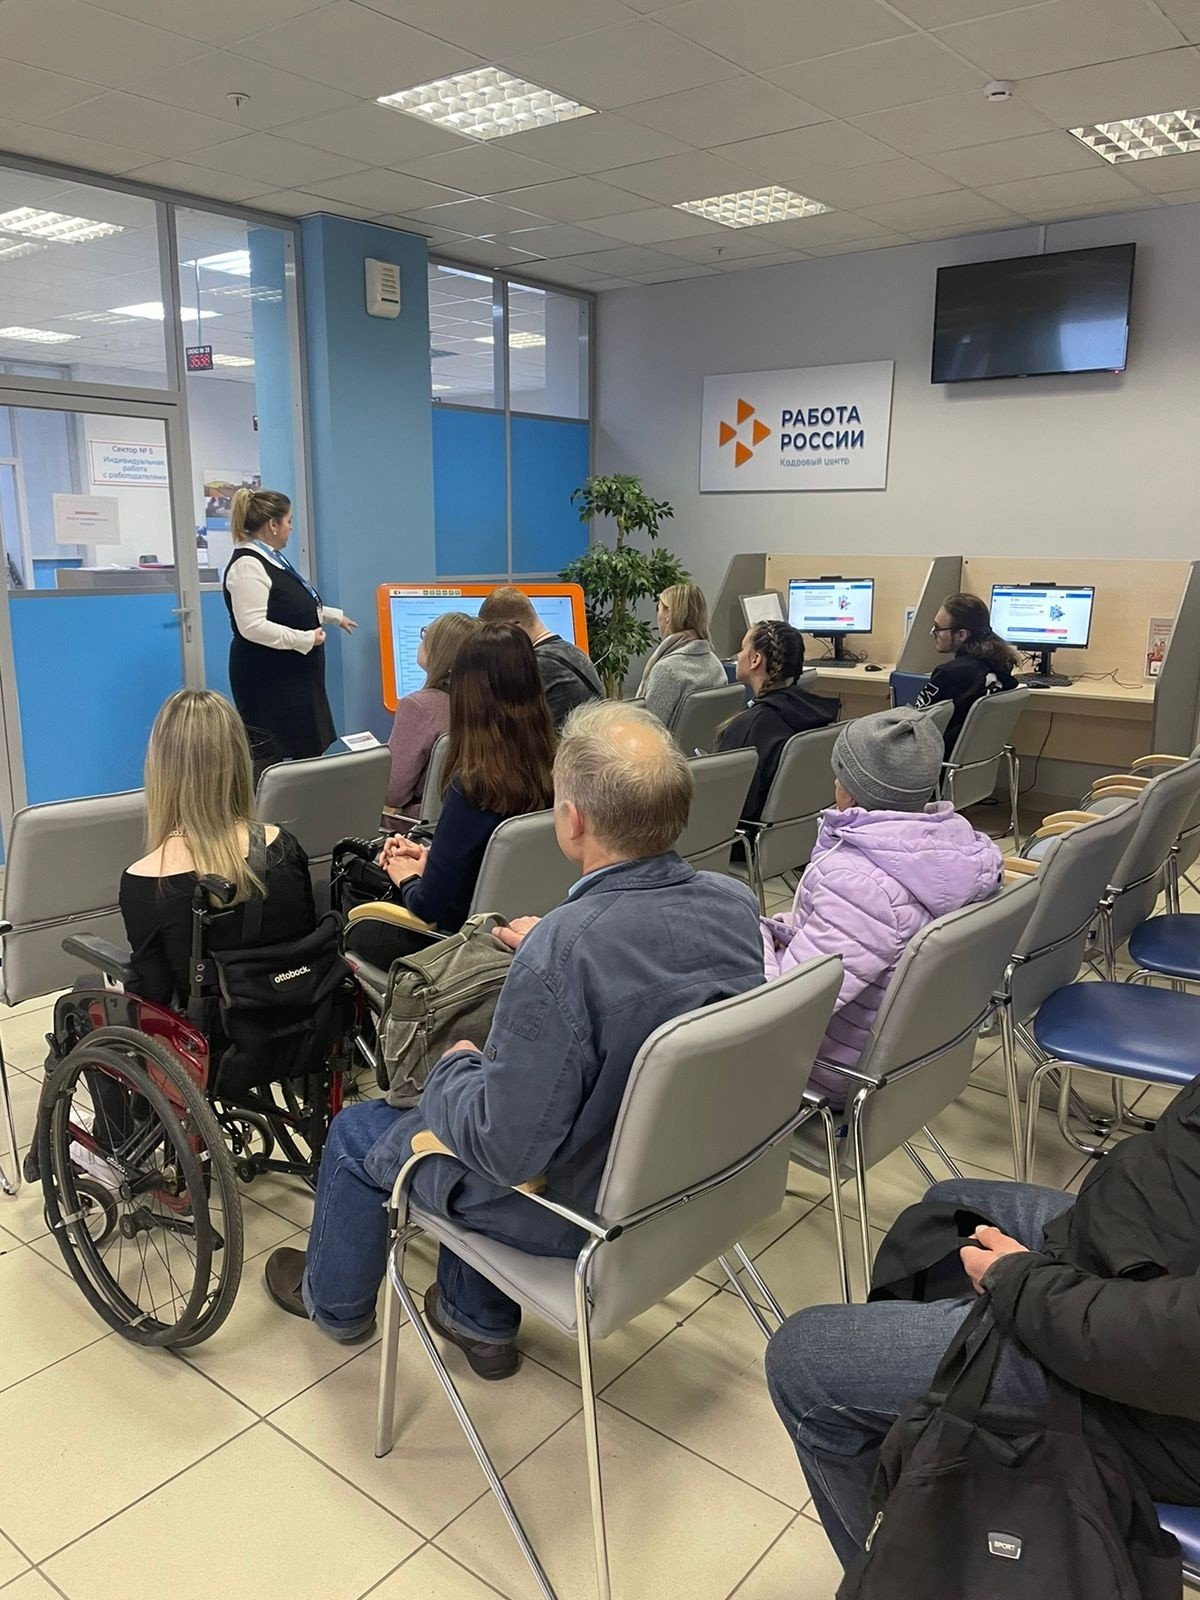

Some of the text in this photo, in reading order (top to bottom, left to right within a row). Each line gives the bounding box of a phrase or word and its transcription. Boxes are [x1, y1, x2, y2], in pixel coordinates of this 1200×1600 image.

[781, 405, 861, 428] РАБОТА
[780, 429, 864, 452] РОССИИ
[111, 445, 138, 455] Сектор
[103, 456, 165, 466] Индивидуальная
[780, 457, 823, 469] Кадровый
[122, 465, 148, 474] работа
[109, 471, 167, 481] работодателями
[993, 1541, 1016, 1551] SPORT
